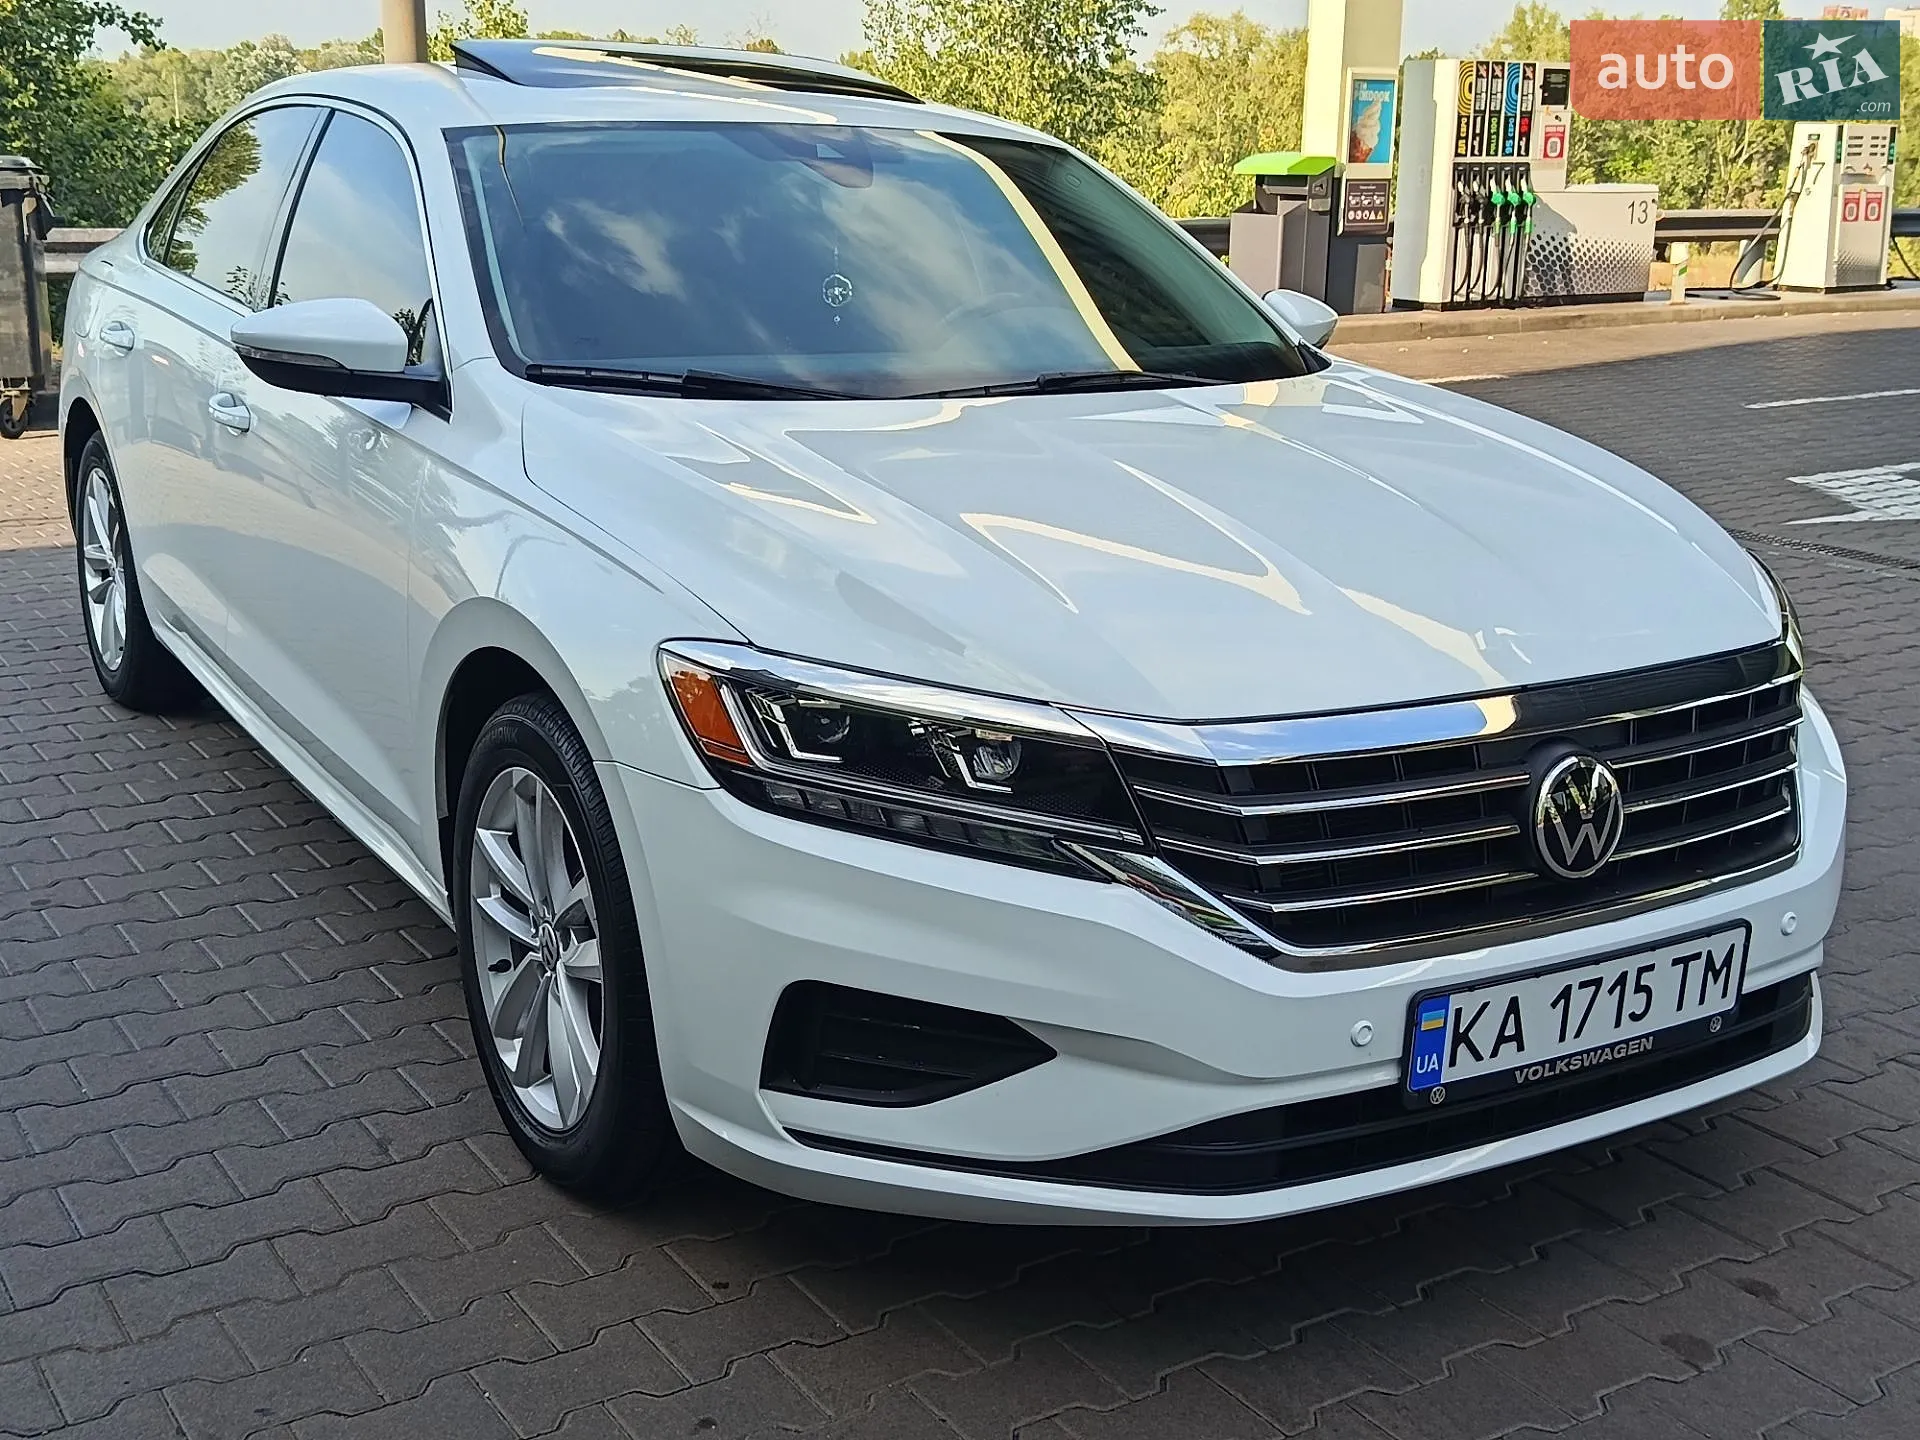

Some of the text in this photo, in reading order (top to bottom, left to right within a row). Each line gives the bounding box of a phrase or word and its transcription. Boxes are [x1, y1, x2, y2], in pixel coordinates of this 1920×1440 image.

[1504, 139, 1513, 154] 95
[1627, 200, 1649, 225] 13
[1448, 943, 1736, 1068] KA 1715 TM
[1416, 1053, 1439, 1074] UA
[1514, 1035, 1655, 1084] VOLKSWAGEN
